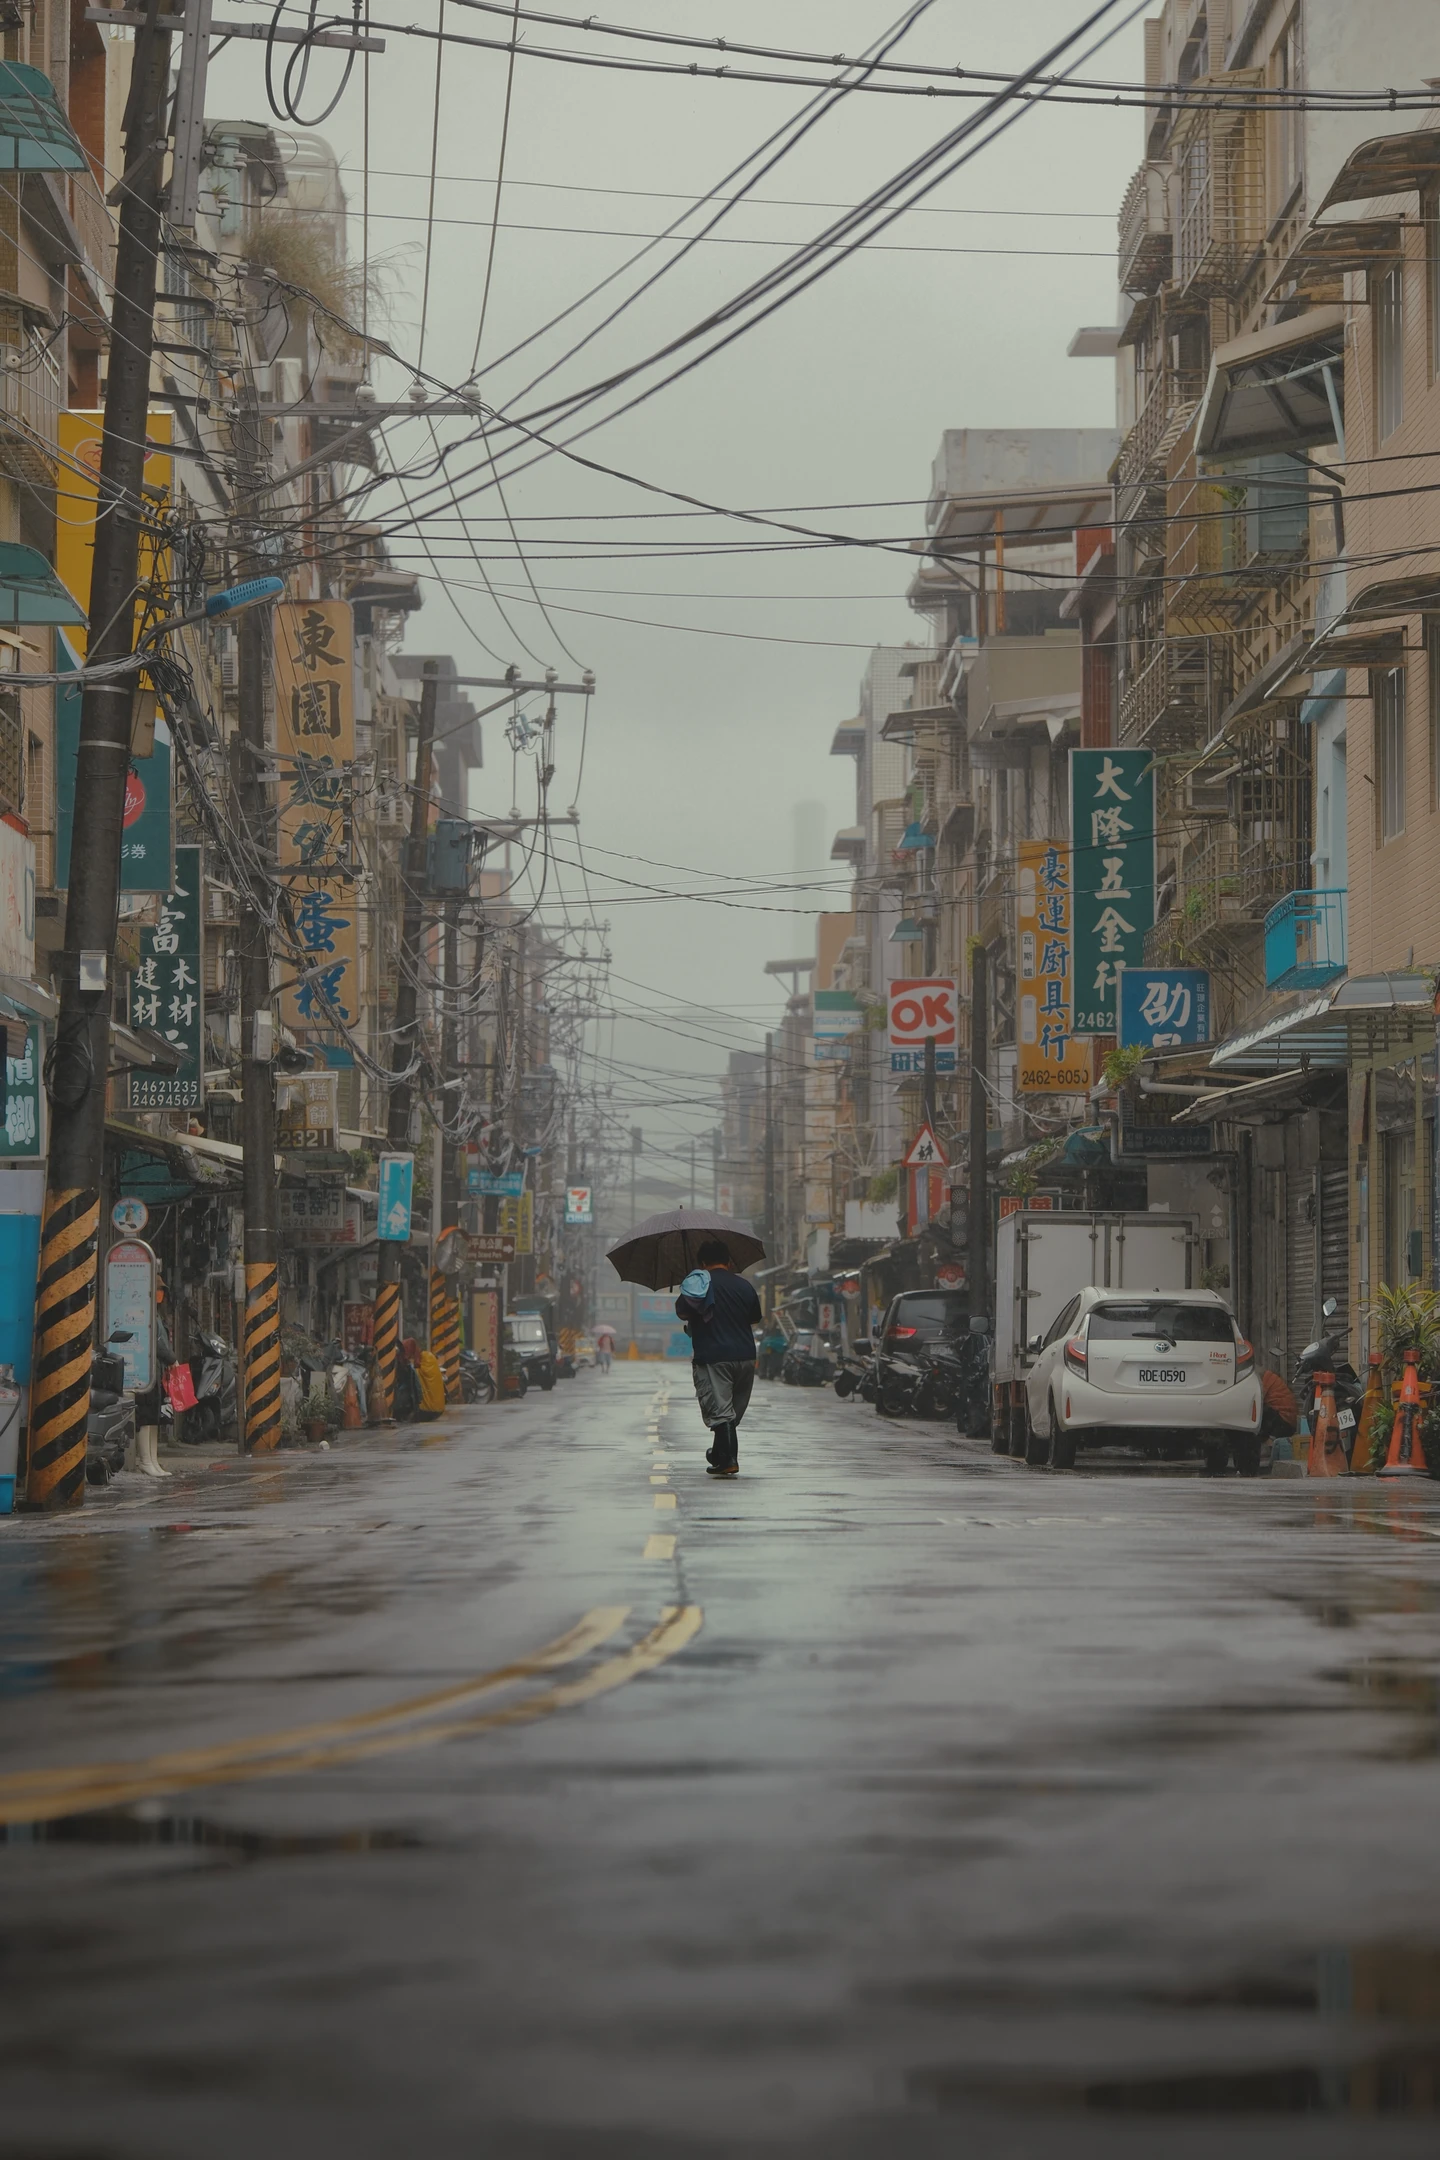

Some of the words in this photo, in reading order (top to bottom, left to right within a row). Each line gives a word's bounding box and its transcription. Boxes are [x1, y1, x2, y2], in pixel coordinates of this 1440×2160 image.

[1039, 847, 1071, 1063] 豪運廚具行
[133, 956, 162, 1027] 建材
[170, 957, 198, 1027] 木材
[891, 992, 955, 1032] OK
[132, 1080, 198, 1094] 24621235
[1022, 1069, 1090, 1086] 2462-6050
[132, 1093, 198, 1107] 24694567
[308, 1082, 329, 1126] 糕餅
[1138, 1369, 1187, 1383] RDE-0590
